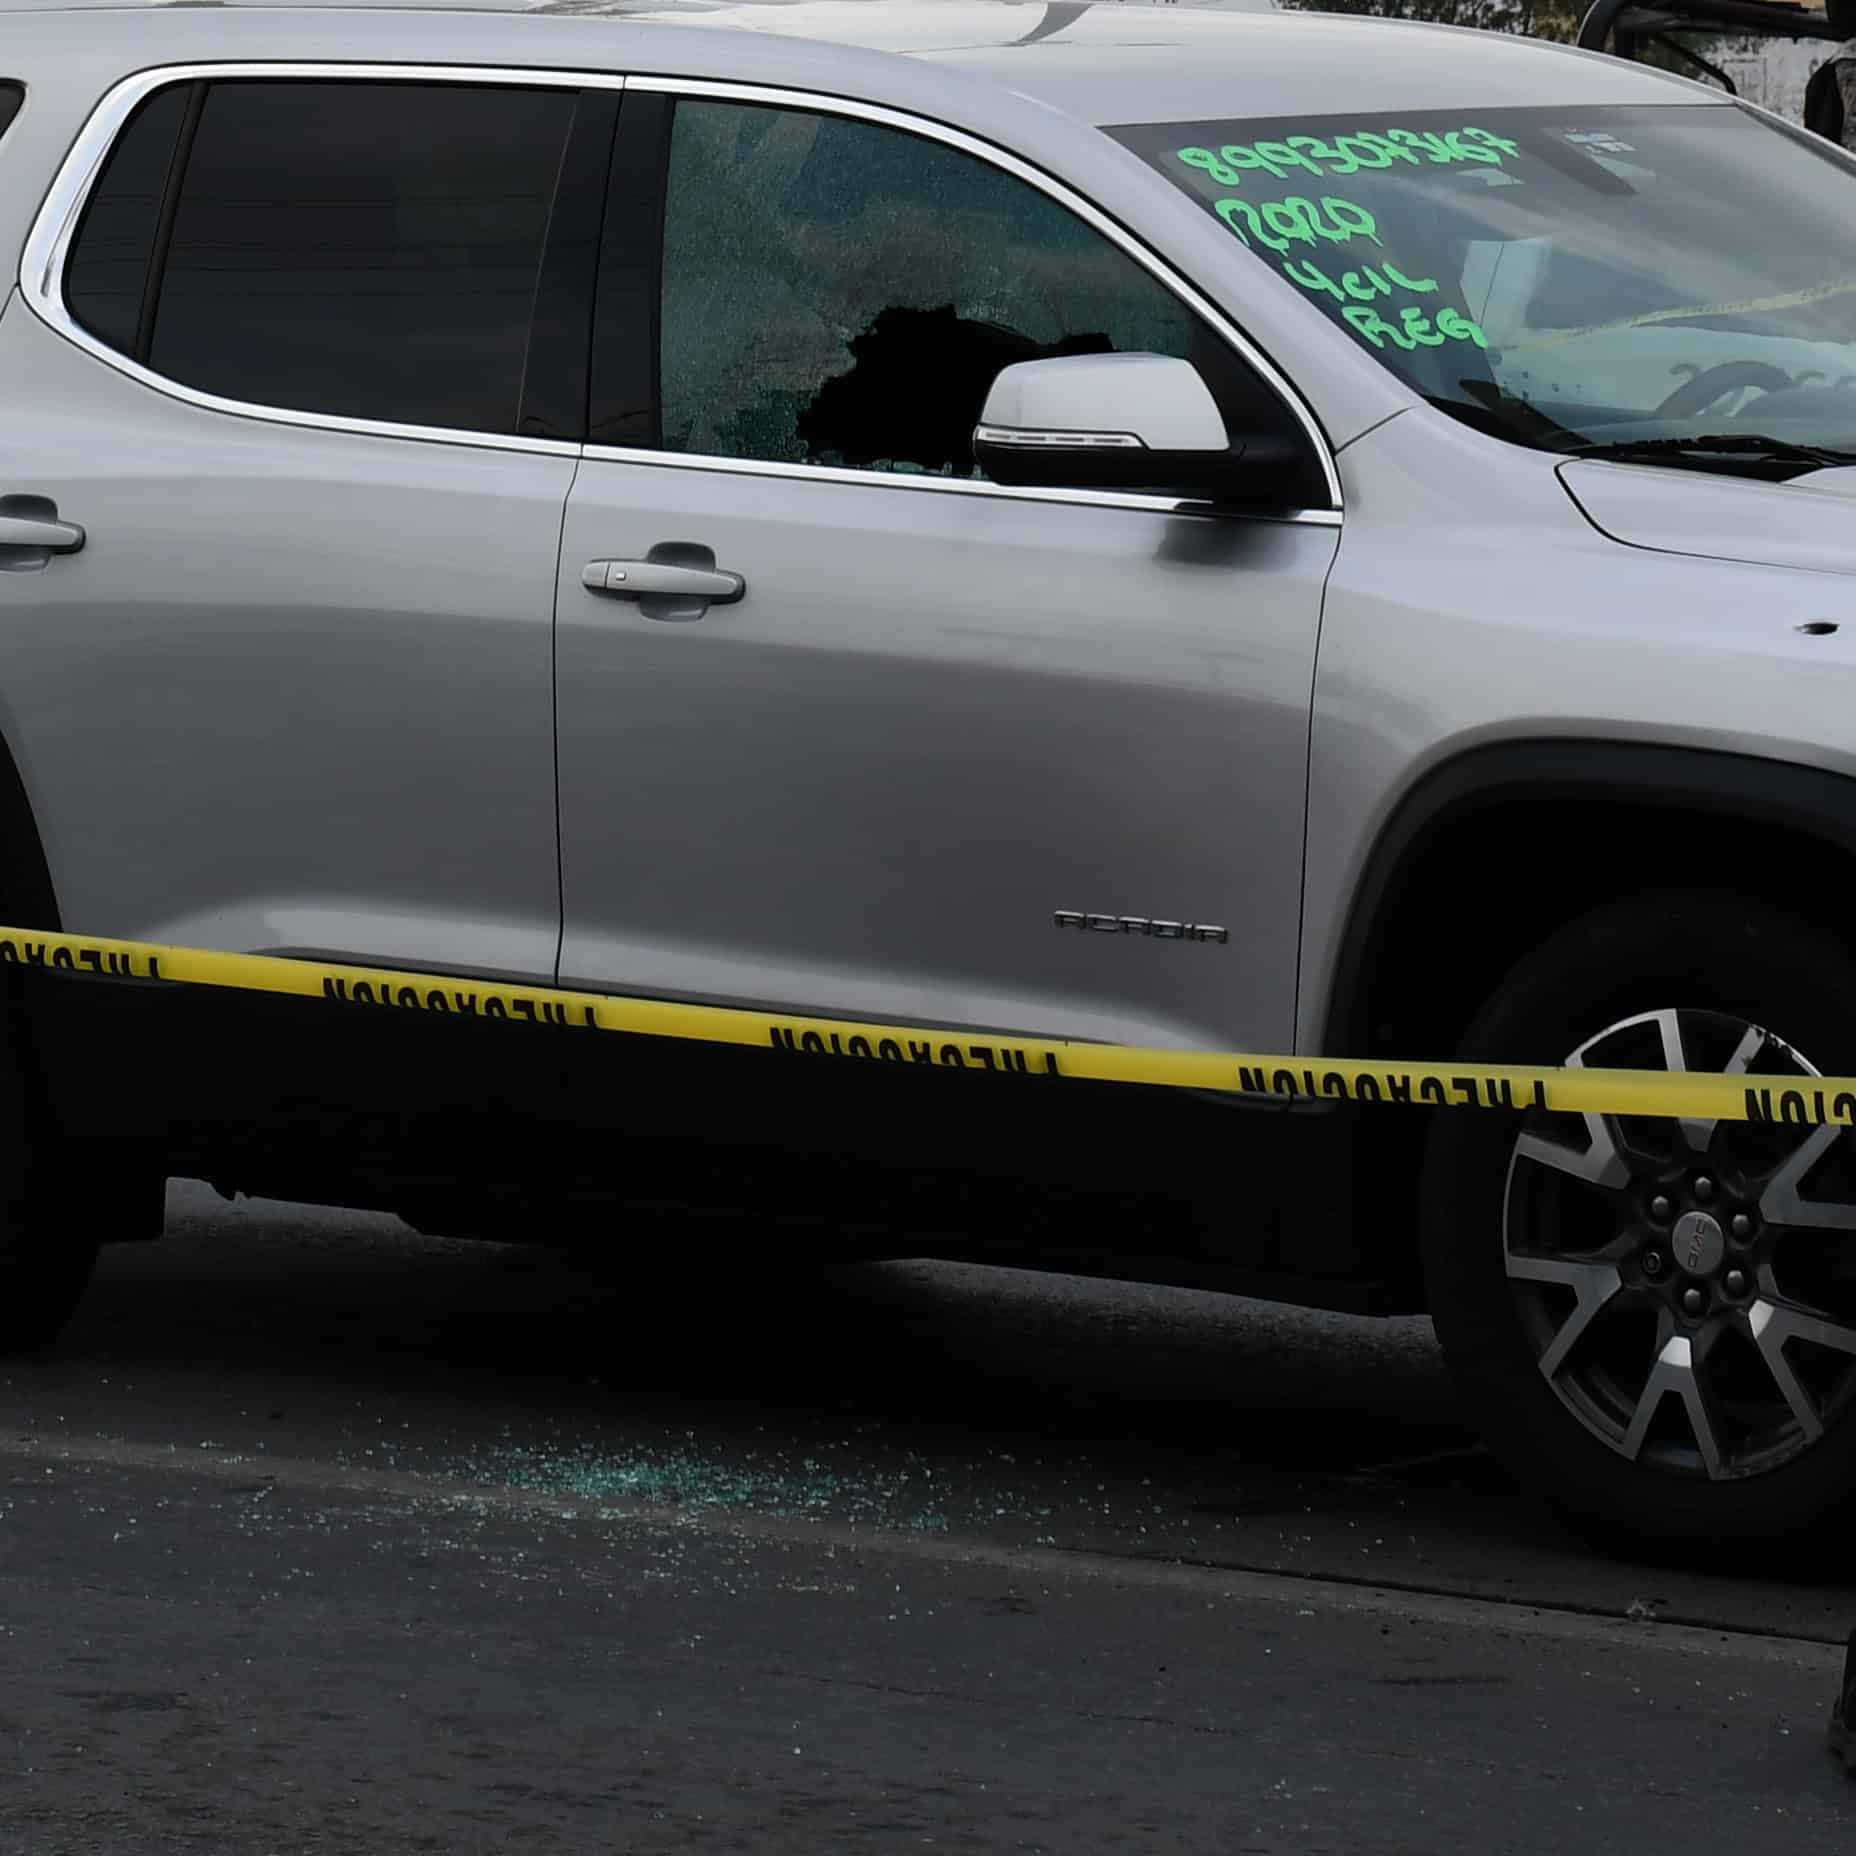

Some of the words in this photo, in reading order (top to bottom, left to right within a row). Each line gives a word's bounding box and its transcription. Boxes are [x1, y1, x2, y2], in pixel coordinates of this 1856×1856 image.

[1214, 196, 1384, 257] 2020
[1342, 306, 1489, 351] REG
[1054, 909, 1229, 945] ACADIA
